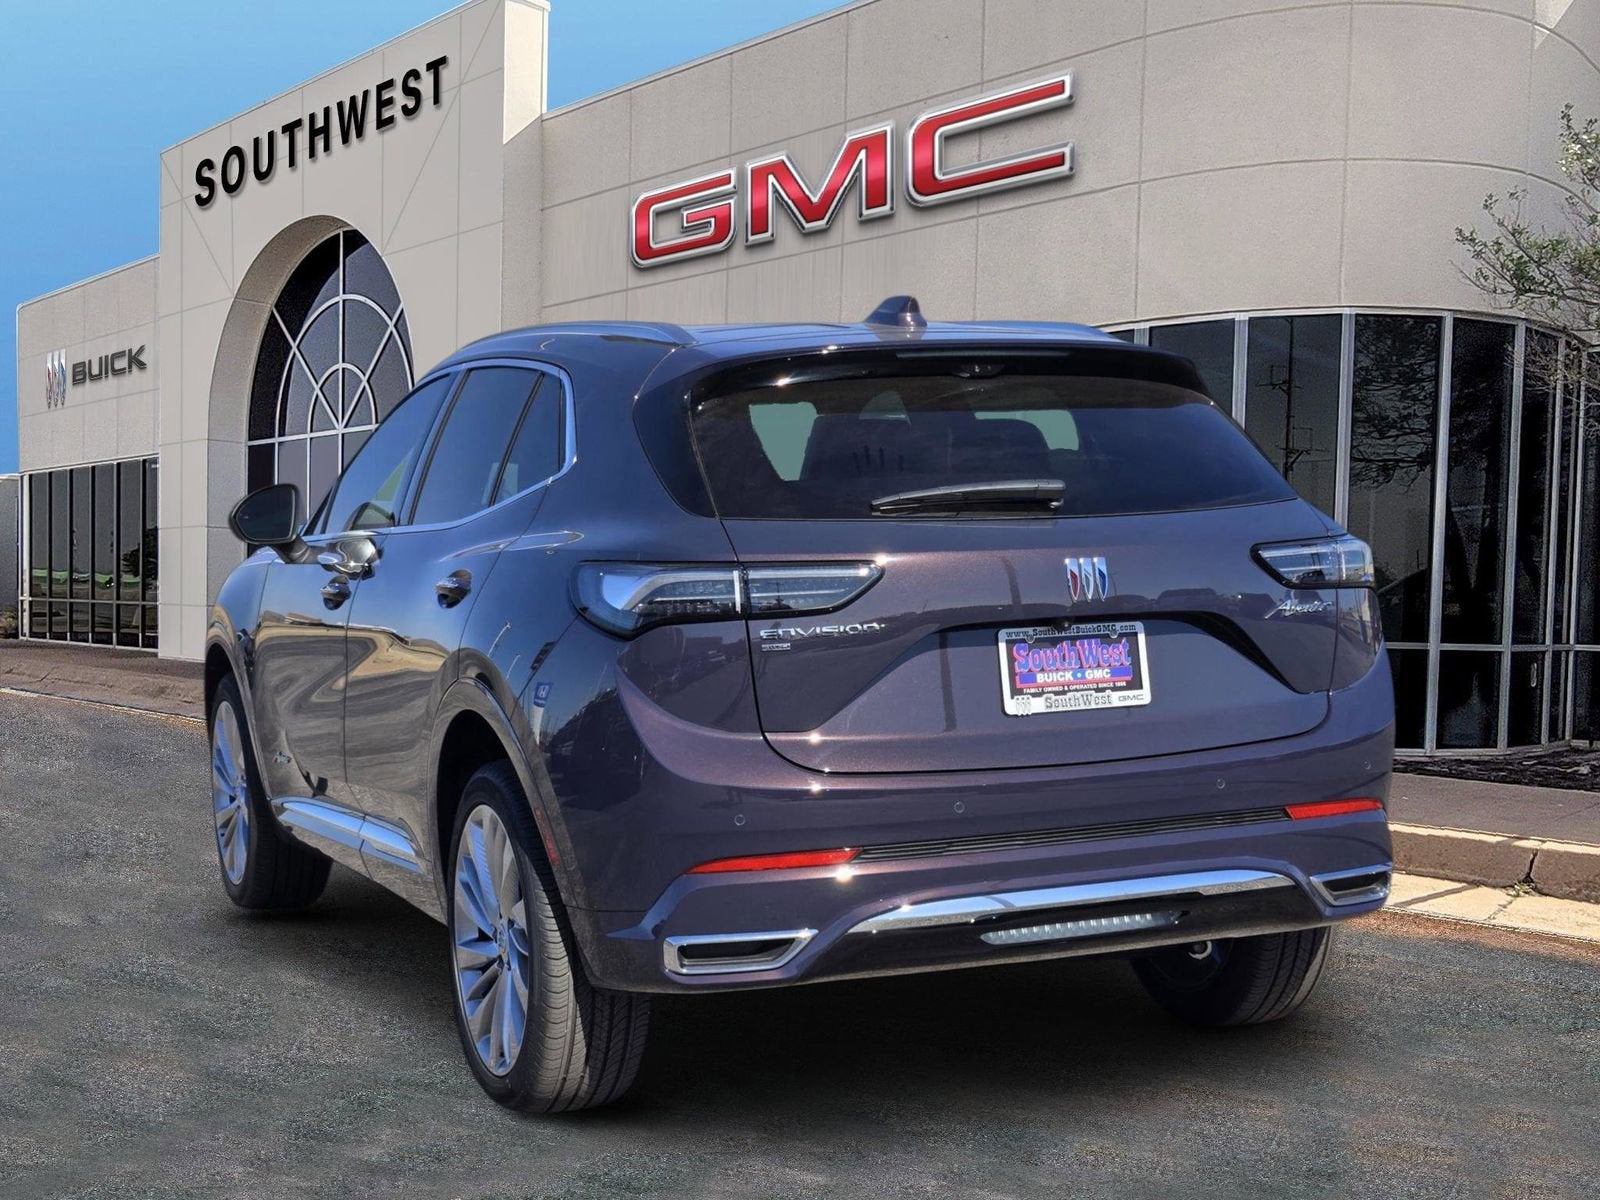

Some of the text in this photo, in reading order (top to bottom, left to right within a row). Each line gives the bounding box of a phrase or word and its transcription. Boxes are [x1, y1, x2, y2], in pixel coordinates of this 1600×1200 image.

[194, 55, 449, 208] SOUTHWEST
[631, 69, 1075, 269] GMC
[72, 344, 147, 386] BUICK
[1013, 637, 1132, 673] SouthWest
[1036, 668, 1111, 683] BUICK GMC
[1044, 692, 1145, 709] SouthWest GMC
